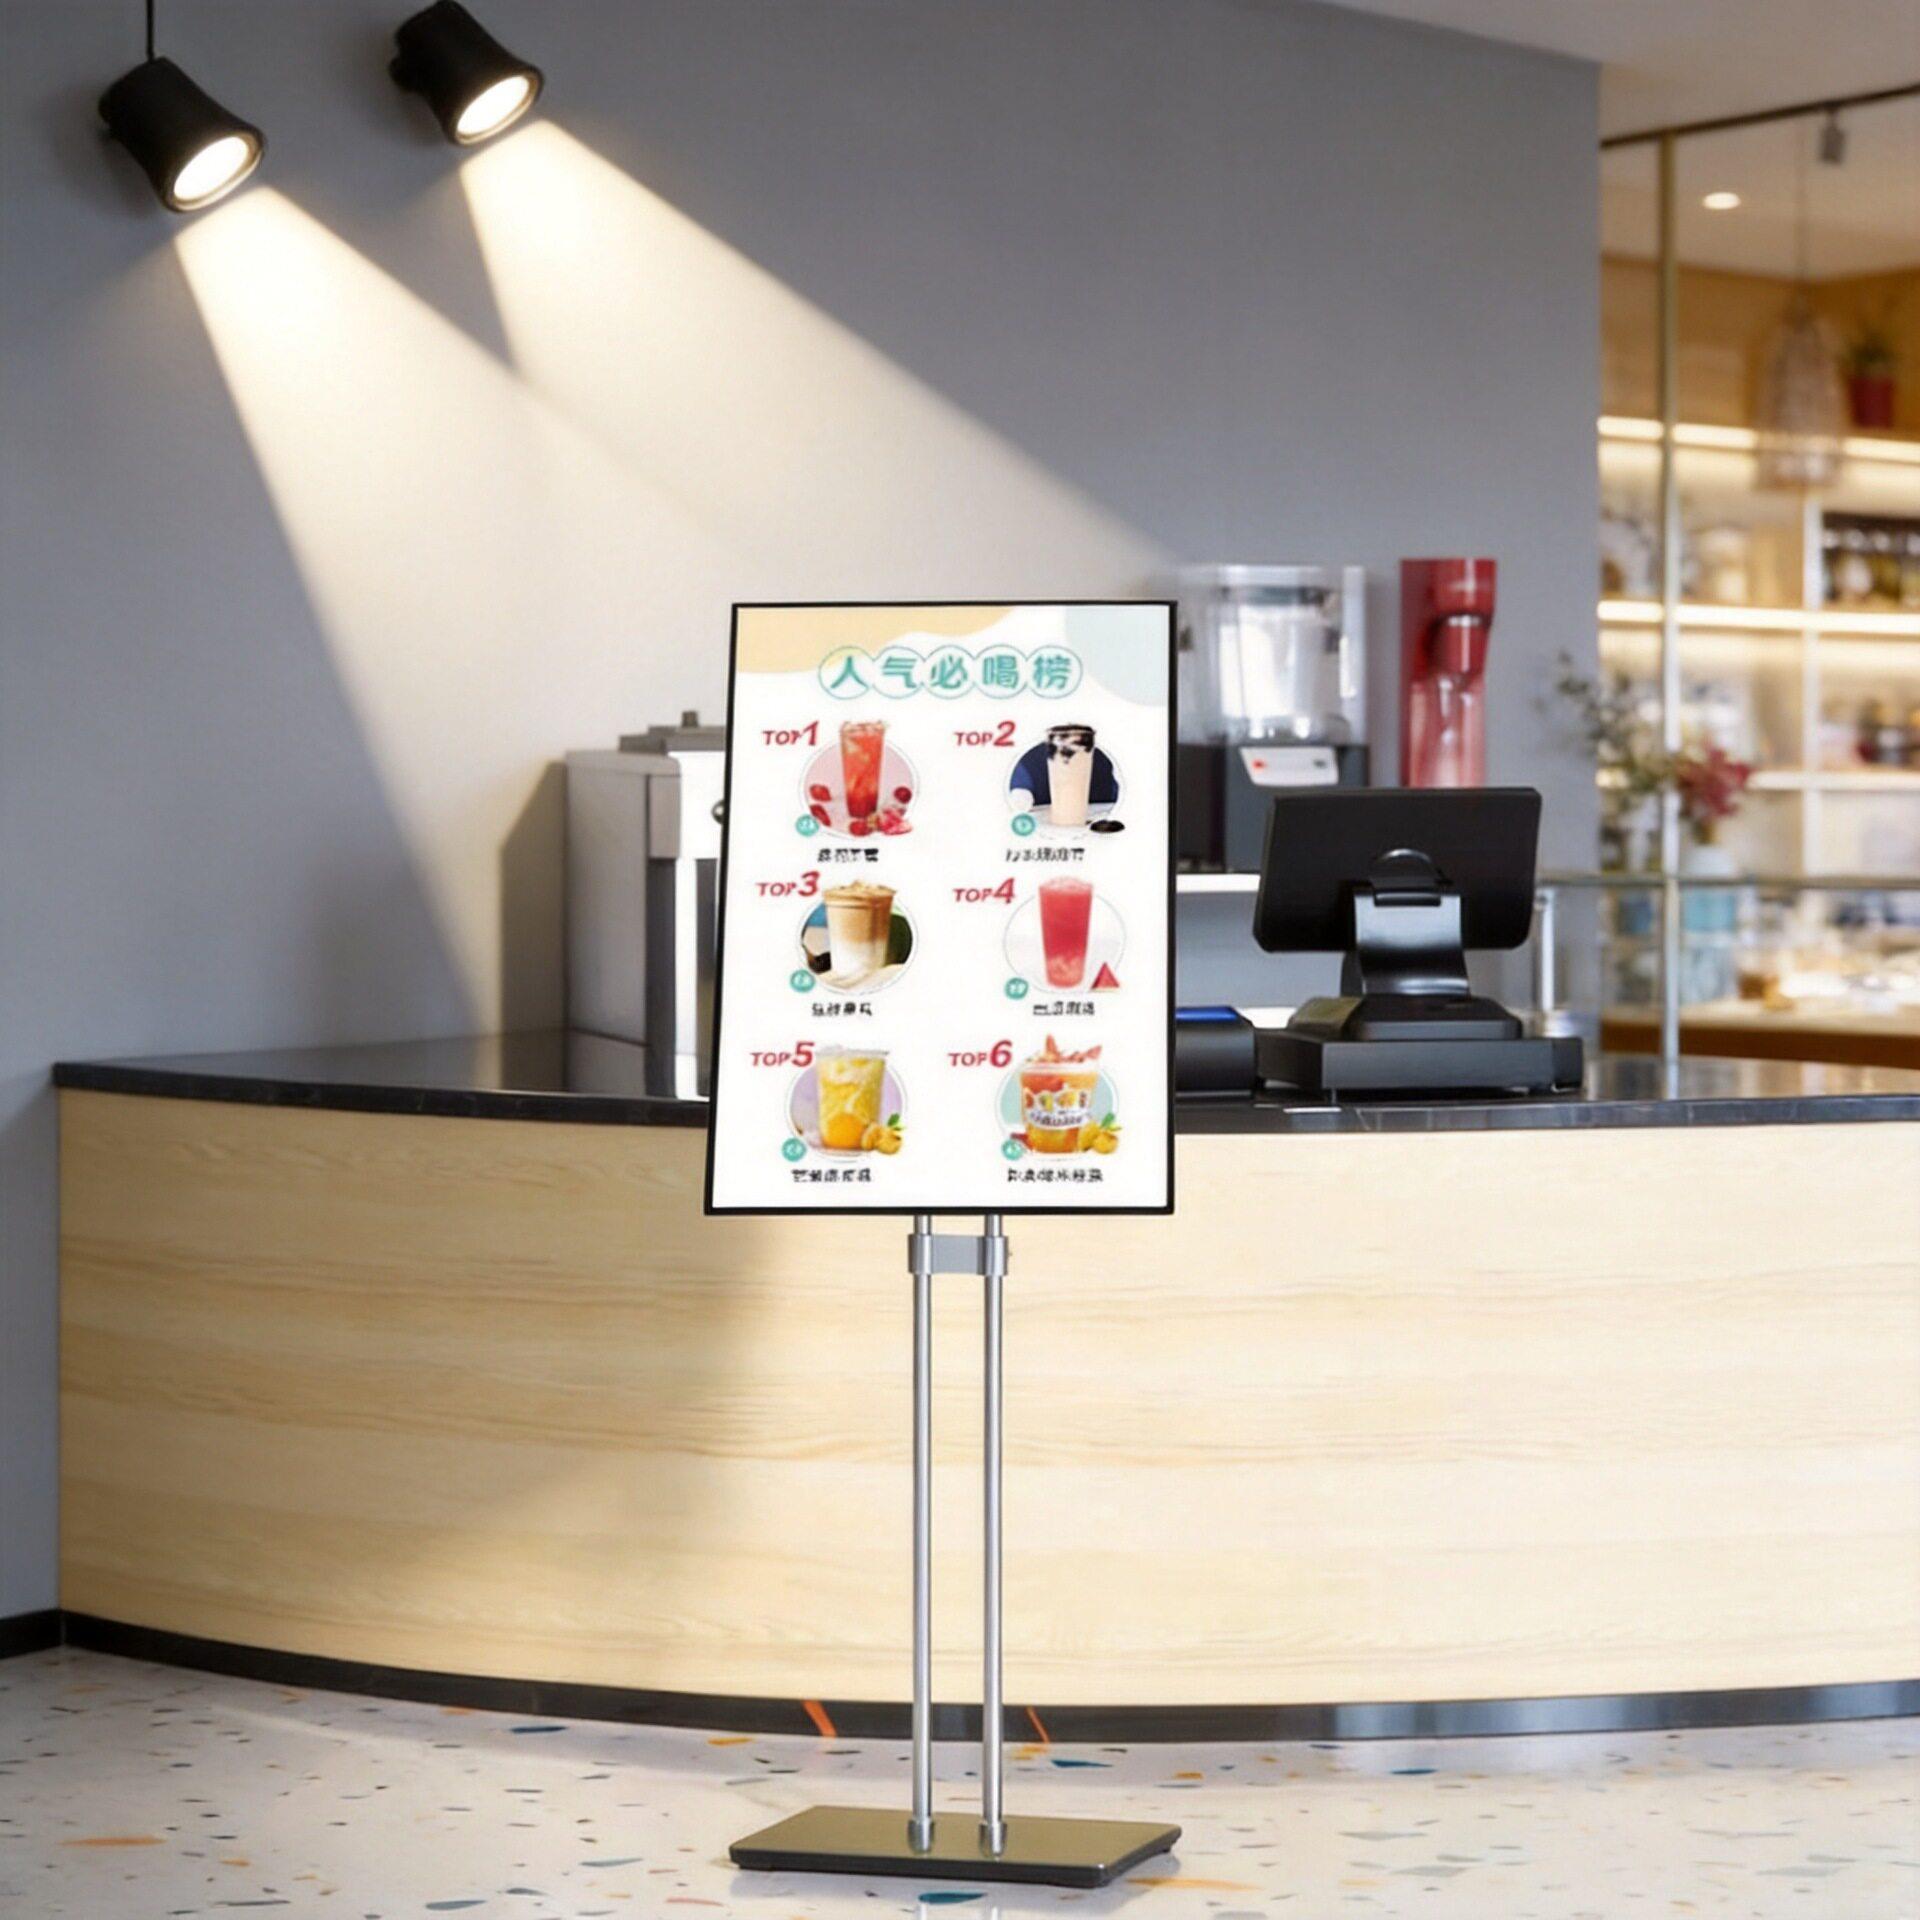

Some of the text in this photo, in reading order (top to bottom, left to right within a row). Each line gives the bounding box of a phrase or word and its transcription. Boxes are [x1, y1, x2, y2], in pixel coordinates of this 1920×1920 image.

[829, 655, 1072, 691] 人气必喝榜
[763, 721, 818, 746] TOP1
[956, 719, 1017, 748] TOP2
[759, 870, 821, 897] TOP3
[953, 877, 1015, 904] TOP4
[751, 1041, 815, 1068] TOP5
[949, 1039, 1013, 1069] TOP6
